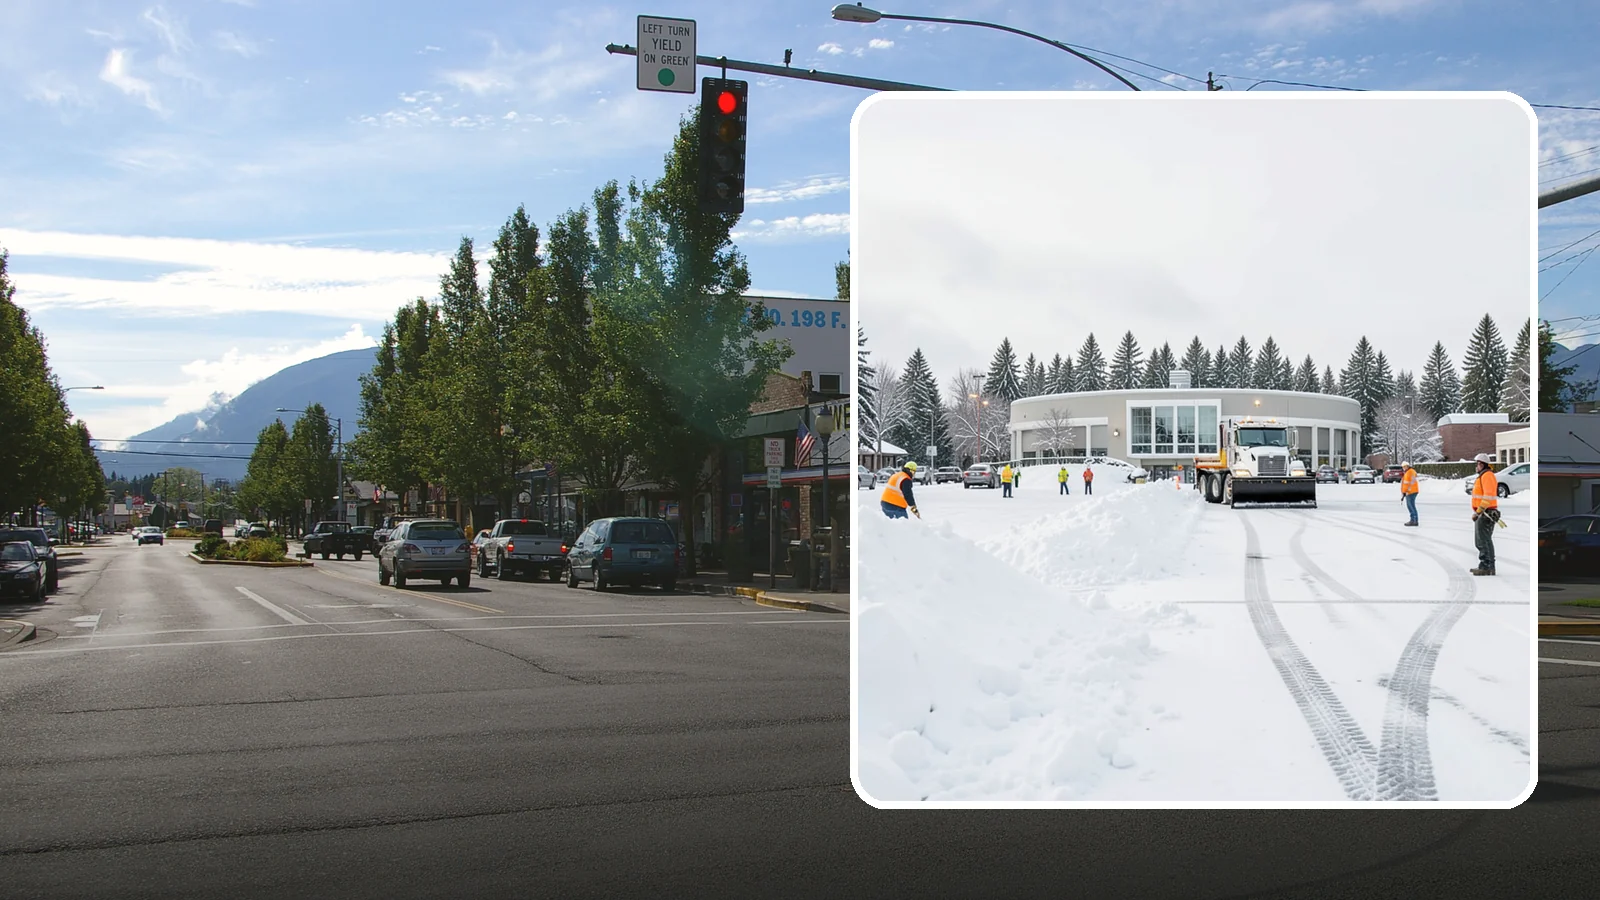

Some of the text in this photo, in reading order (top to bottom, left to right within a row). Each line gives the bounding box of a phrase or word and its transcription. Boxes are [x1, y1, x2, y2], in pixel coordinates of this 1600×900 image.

[643, 23, 690, 37] LEFT TURN
[652, 38, 682, 52] YIELD
[644, 53, 689, 66] ON GREEN
[791, 309, 826, 328] 198
[831, 311, 847, 329] F.
